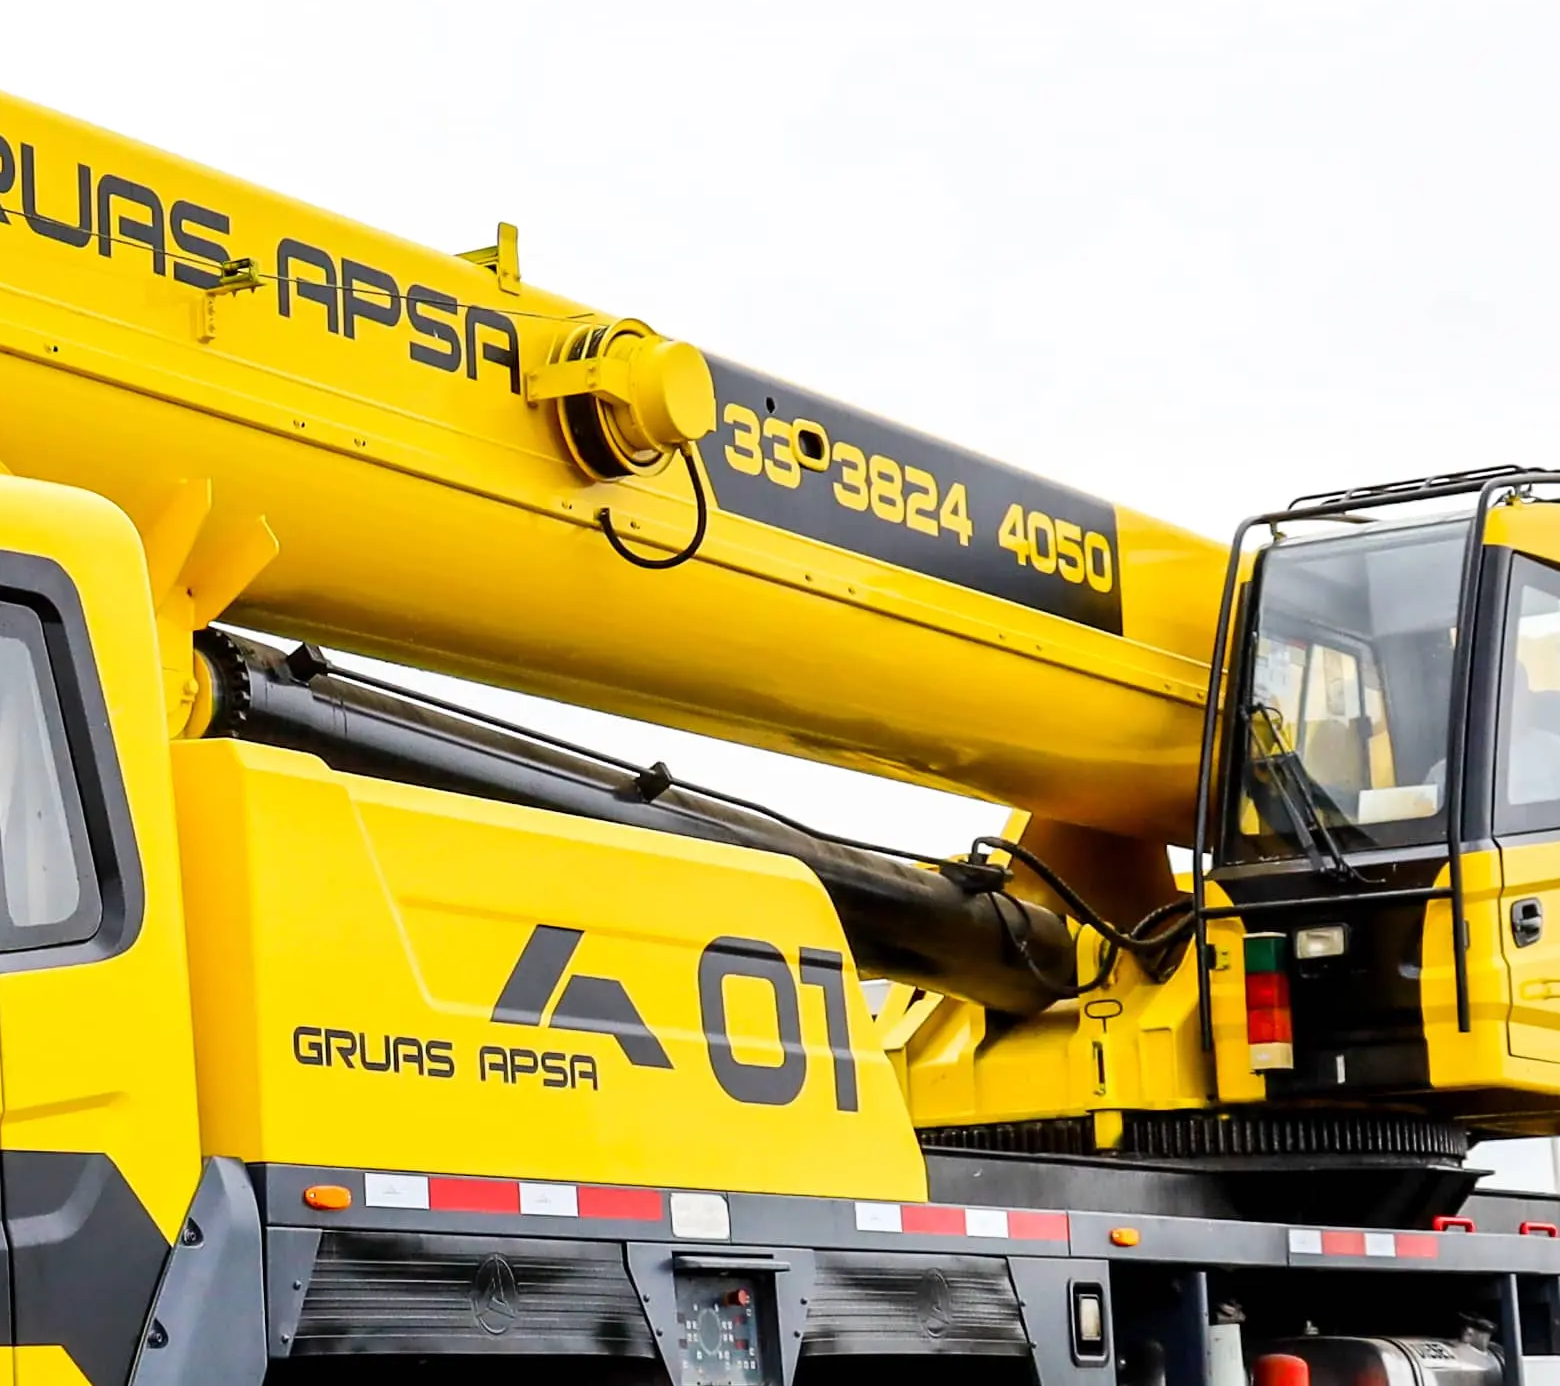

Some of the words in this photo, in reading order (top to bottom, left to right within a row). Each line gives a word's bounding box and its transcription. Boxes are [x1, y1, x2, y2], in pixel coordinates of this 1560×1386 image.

[278, 238, 521, 394] APSA
[723, 403, 801, 489] 33
[832, 442, 973, 546] 3824
[997, 503, 1113, 593] 4050
[293, 1026, 455, 1079] GRUAS
[479, 1045, 599, 1091] APSA
[697, 935, 859, 1113] 01
